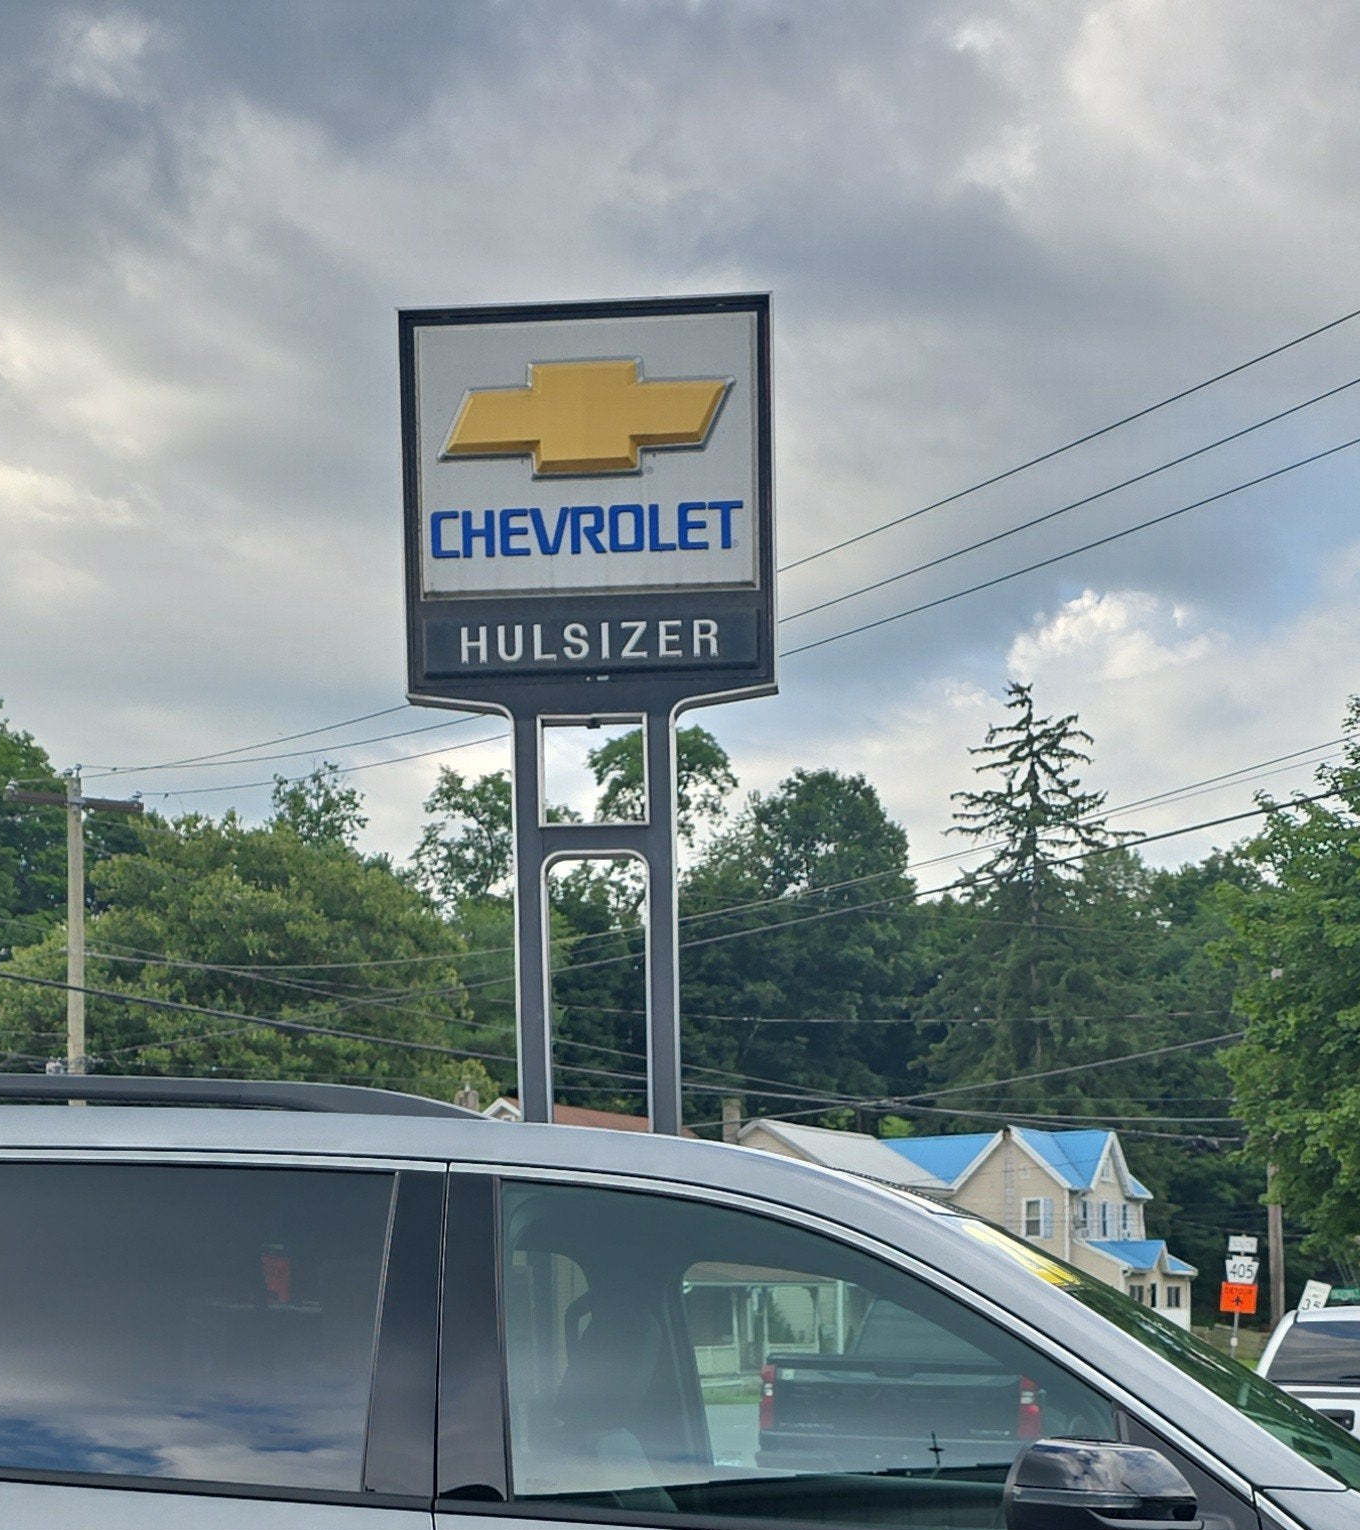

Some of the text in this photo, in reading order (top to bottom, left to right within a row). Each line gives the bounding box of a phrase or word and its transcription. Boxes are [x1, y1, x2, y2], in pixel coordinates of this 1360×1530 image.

[430, 500, 743, 559] CHEVROLET
[460, 619, 720, 664] HULSIZER
[1230, 1263, 1254, 1279] 405
